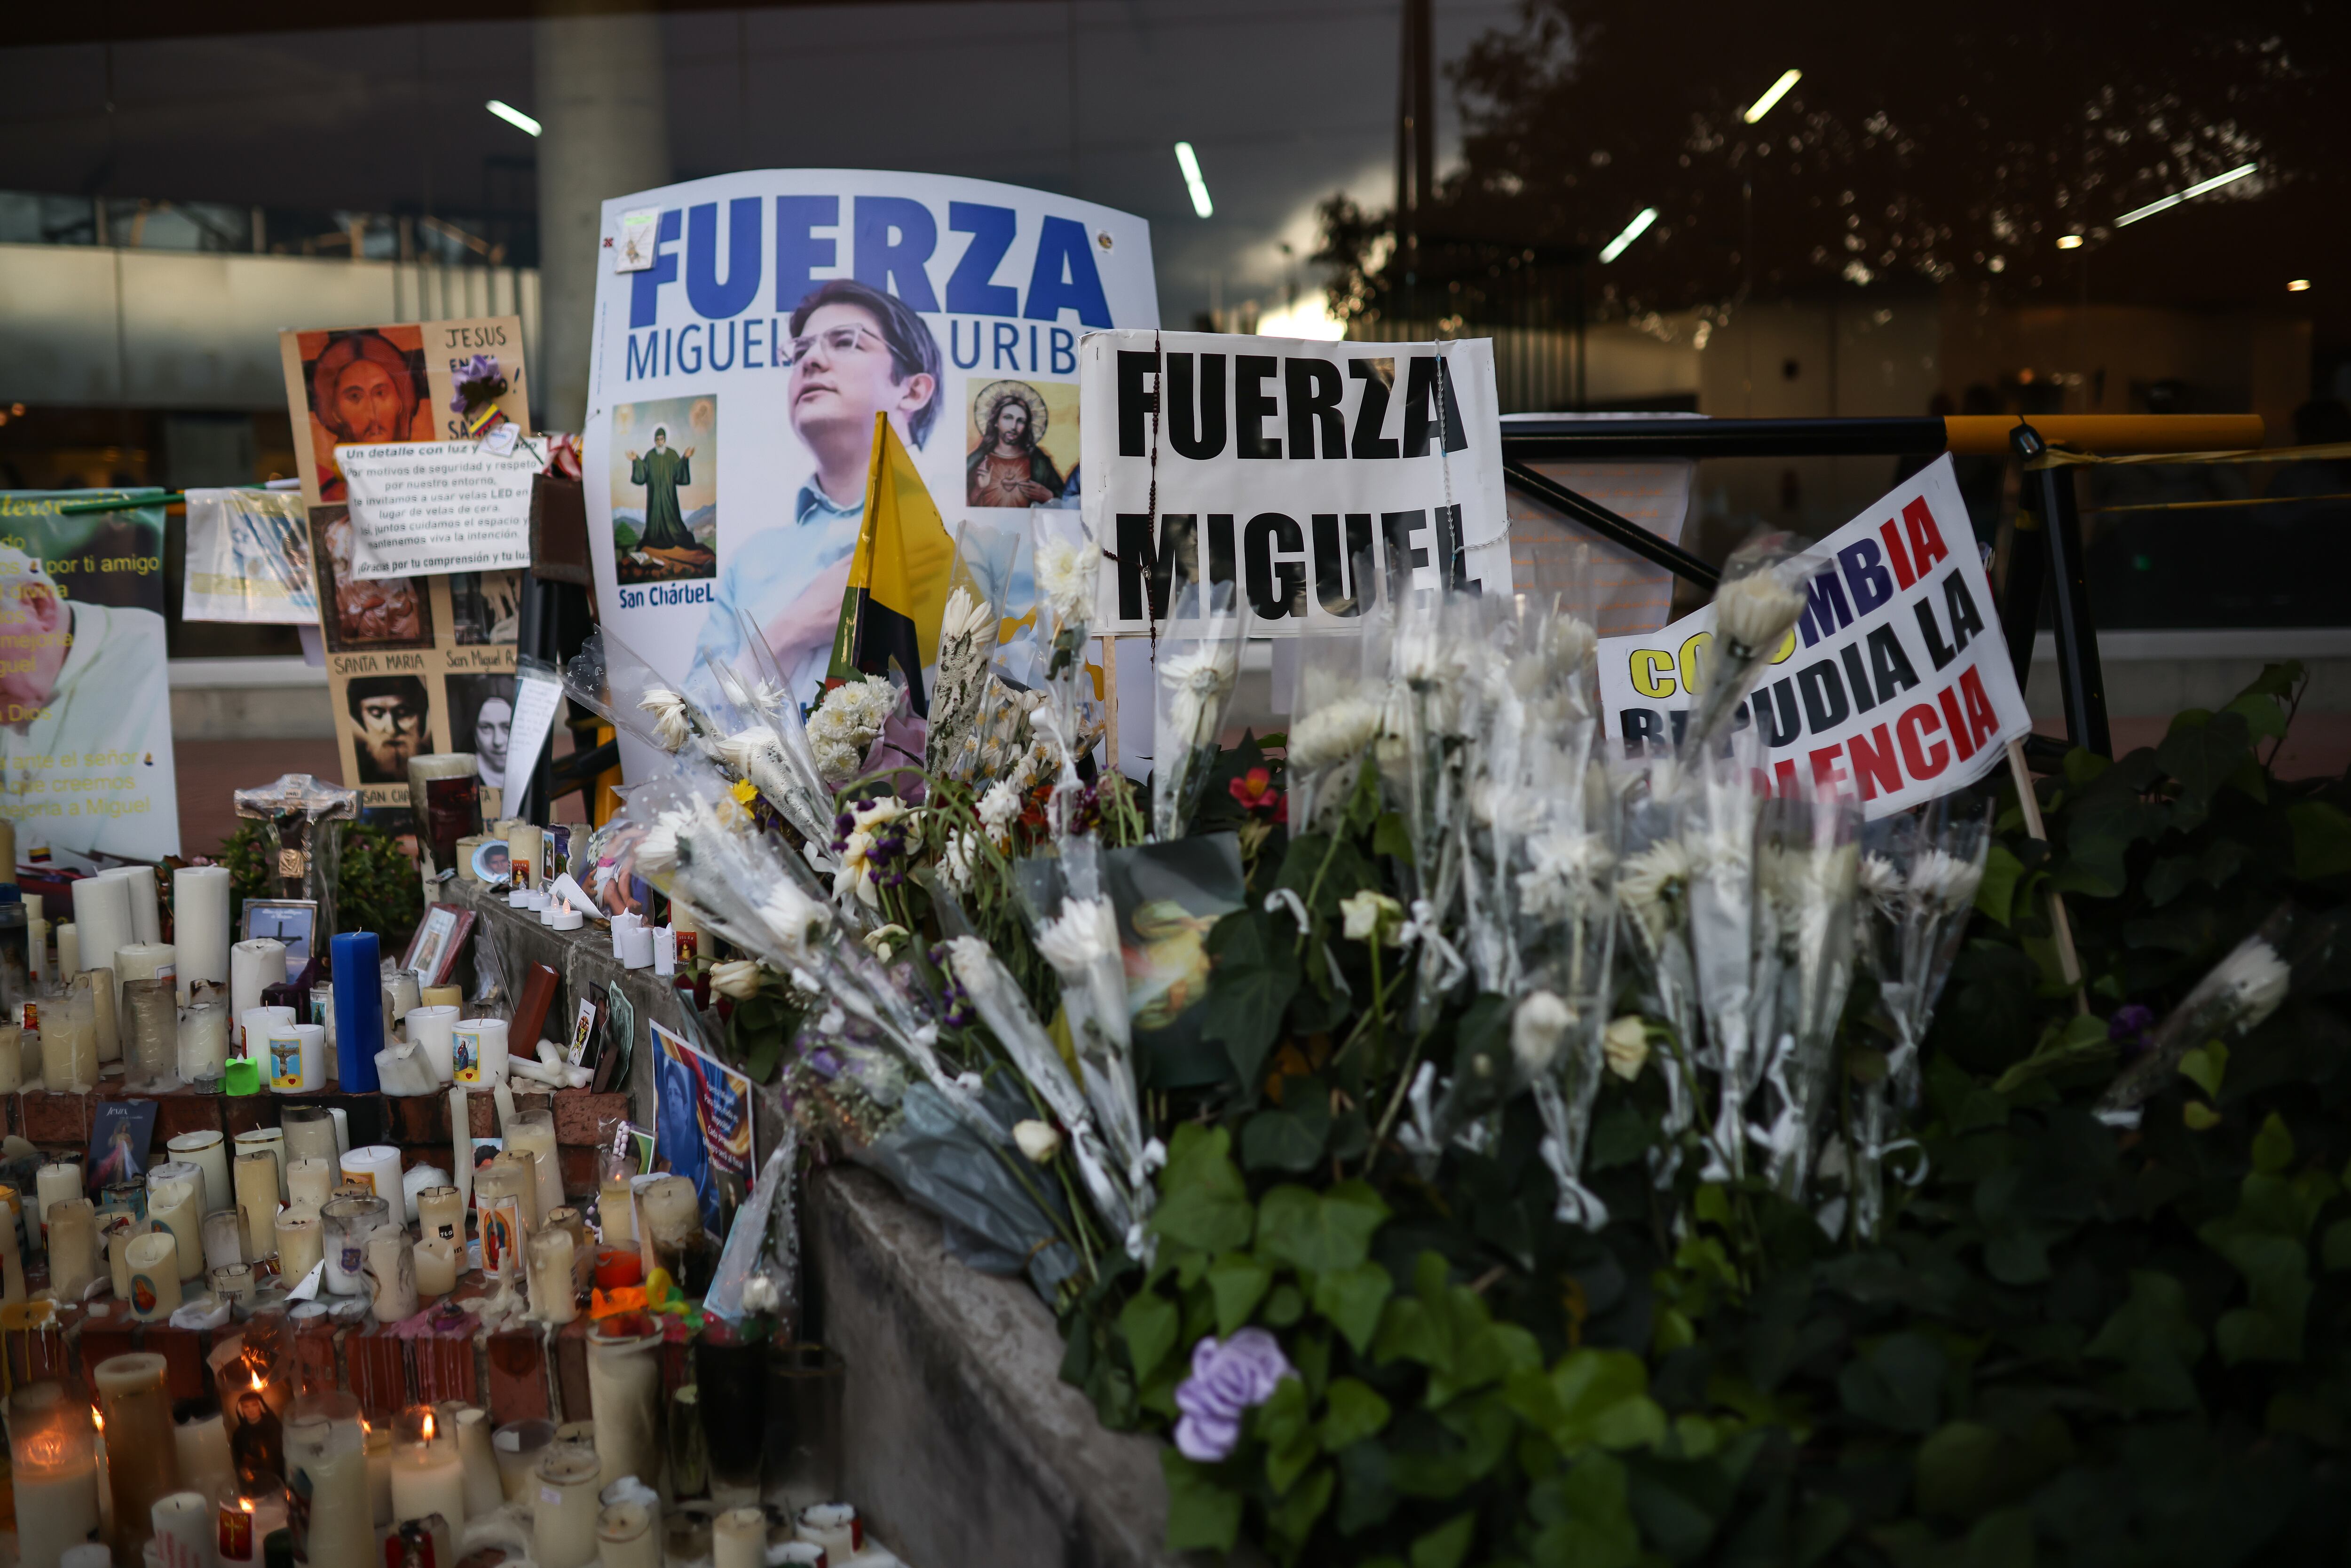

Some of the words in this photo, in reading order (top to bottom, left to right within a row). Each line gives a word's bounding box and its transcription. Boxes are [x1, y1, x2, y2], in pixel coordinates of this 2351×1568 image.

[629, 194, 1113, 329] FUERZA
[445, 325, 506, 349] JESUS
[951, 320, 1078, 374] URIB
[1117, 350, 1468, 460] FUERZA
[347, 448, 364, 460] Un
[368, 447, 415, 459] detalle
[418, 445, 443, 456] con
[448, 443, 467, 454] luz
[366, 465, 410, 477] motivos
[413, 464, 425, 474] de
[428, 461, 482, 474] seguridad
[486, 462, 491, 472] y
[495, 459, 537, 471] respeto
[385, 481, 404, 492] por
[407, 479, 448, 490] nuestro
[354, 498, 363, 507] te
[366, 494, 418, 506] invitamos
[431, 492, 455, 502] usar
[459, 490, 488, 501] velas
[491, 489, 513, 499] LED
[516, 488, 529, 497] en
[379, 509, 406, 520] lugar
[410, 506, 422, 516] de
[426, 505, 454, 515] velas
[458, 504, 471, 514] de
[375, 522, 406, 536] juntos
[410, 520, 461, 531] cuidamos
[465, 517, 474, 526] el
[478, 516, 520, 528] espacio
[430, 534, 450, 542] viva
[455, 531, 464, 542] la
[46, 558, 79, 577] por
[83, 555, 95, 573] ti
[100, 552, 160, 576] amigo
[392, 559, 409, 573] por
[411, 558, 422, 569] tu
[424, 550, 489, 568] comprensión
[493, 553, 498, 563] y
[502, 551, 513, 561] tu
[1116, 503, 1482, 621] MIGUEL
[619, 588, 644, 608] San
[1630, 494, 1949, 698] COMBIA
[1913, 567, 1984, 672] LA
[334, 655, 378, 674] SANTA
[386, 653, 425, 670] MARIA
[446, 649, 468, 668] San
[472, 649, 501, 672] Miguel
[8, 703, 53, 722] Dios
[13, 753, 55, 770] ante
[60, 749, 78, 768] el
[84, 749, 140, 767] señor
[10, 778, 46, 797] que
[52, 776, 136, 793] creemos
[69, 801, 81, 816] a
[86, 796, 151, 819] Miguel
